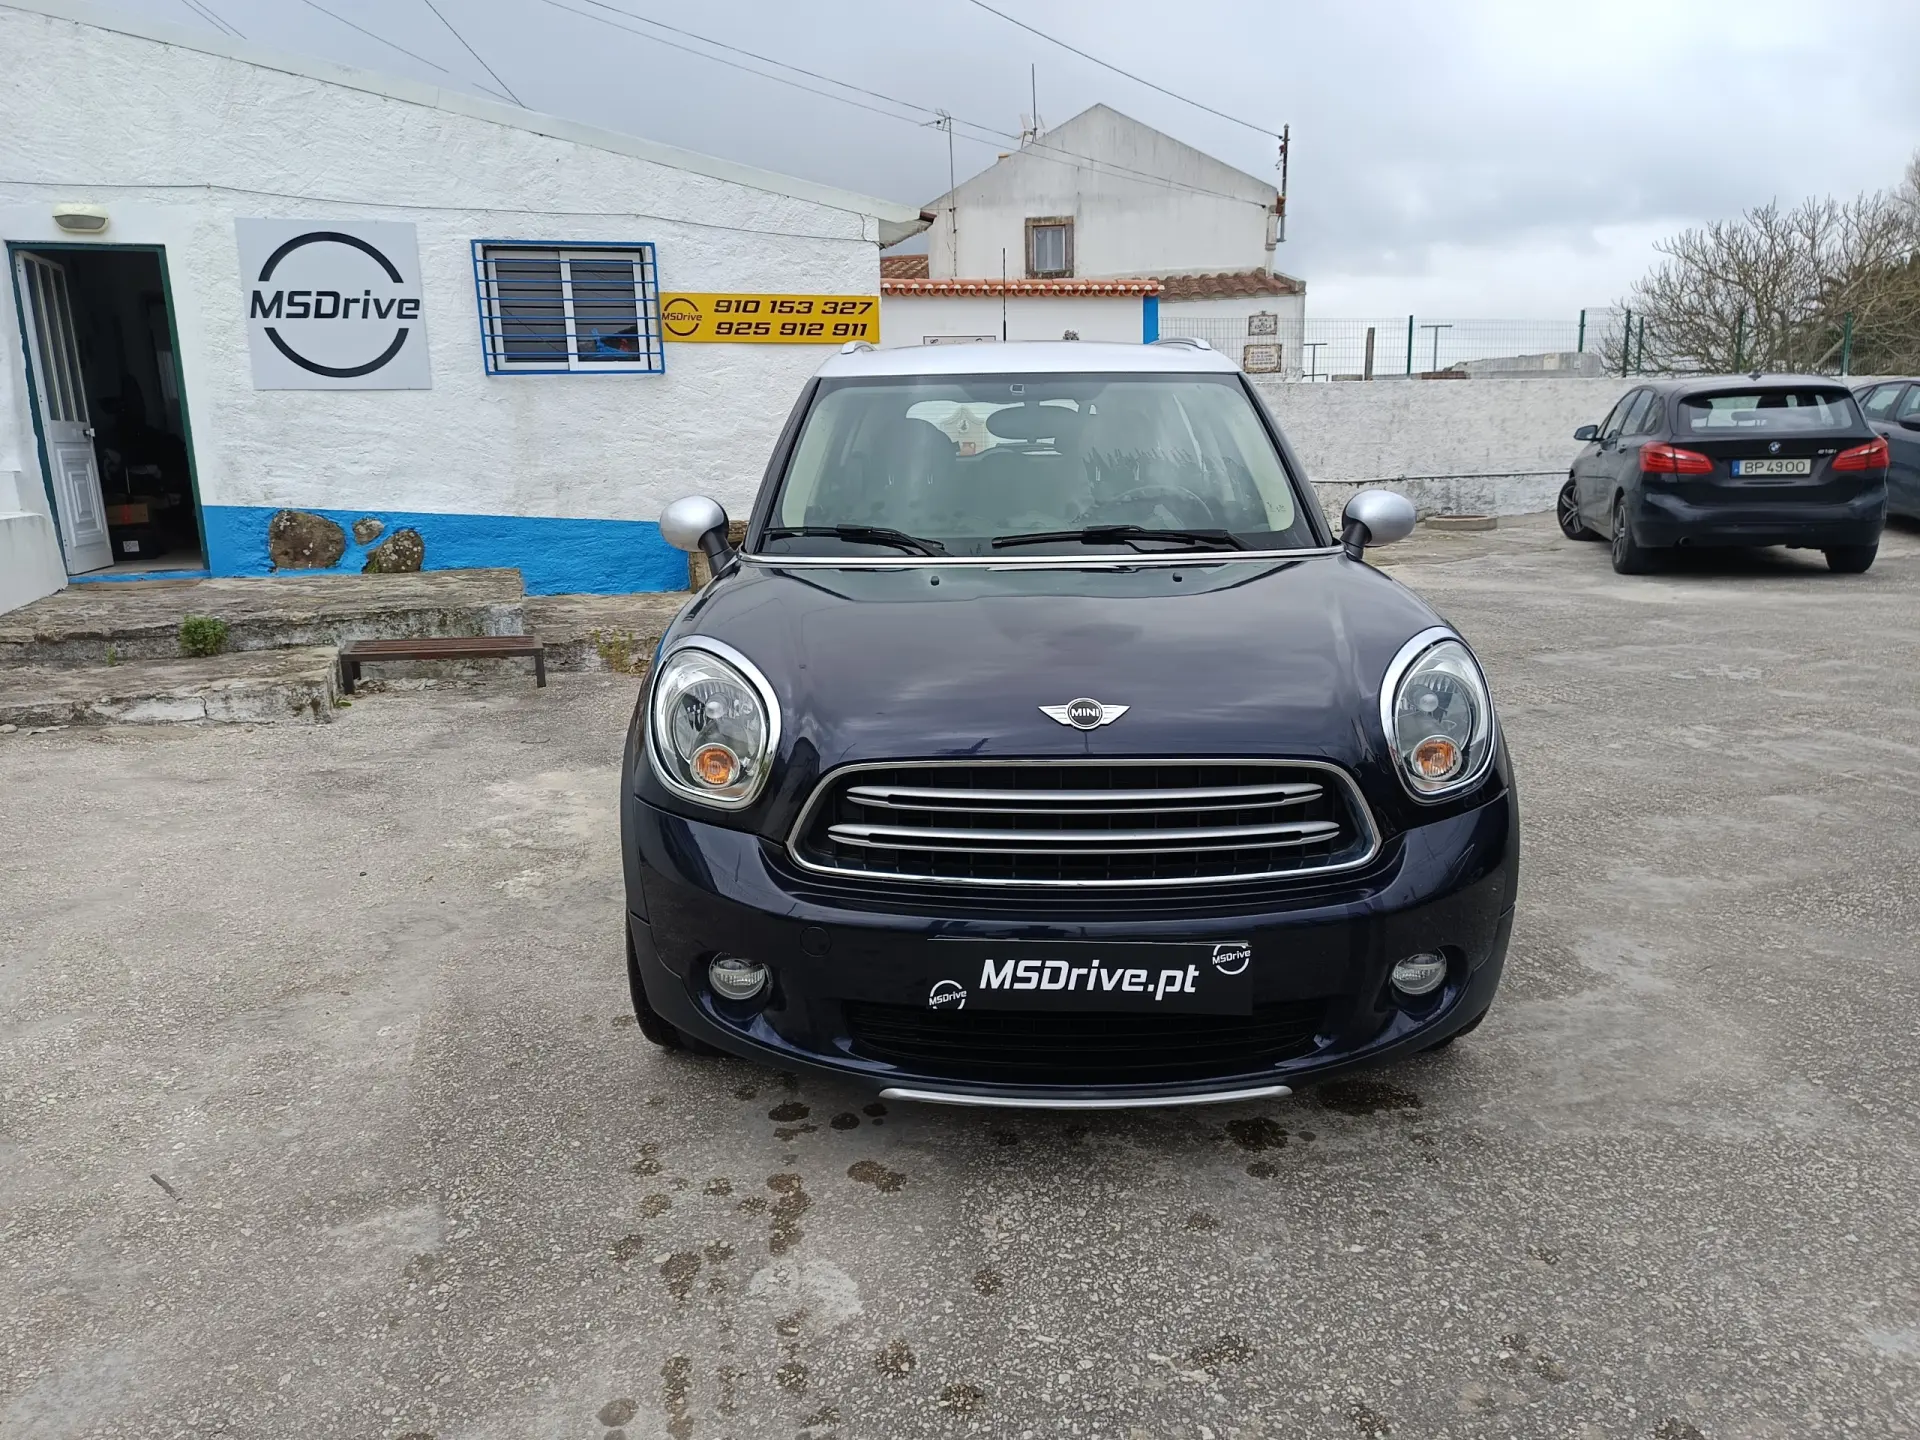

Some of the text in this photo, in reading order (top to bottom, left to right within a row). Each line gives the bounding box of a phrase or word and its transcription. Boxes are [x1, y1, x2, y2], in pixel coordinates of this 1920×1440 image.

[250, 289, 420, 320] MSDrive
[713, 299, 873, 315] 910 153 327
[661, 312, 703, 322] MSDrive
[714, 321, 868, 337] 925 912 911
[1071, 708, 1100, 717] MINI
[1212, 949, 1251, 965] MSDrive
[979, 959, 1200, 1001] MSDrive.pt
[928, 990, 967, 1006] MSDrive
